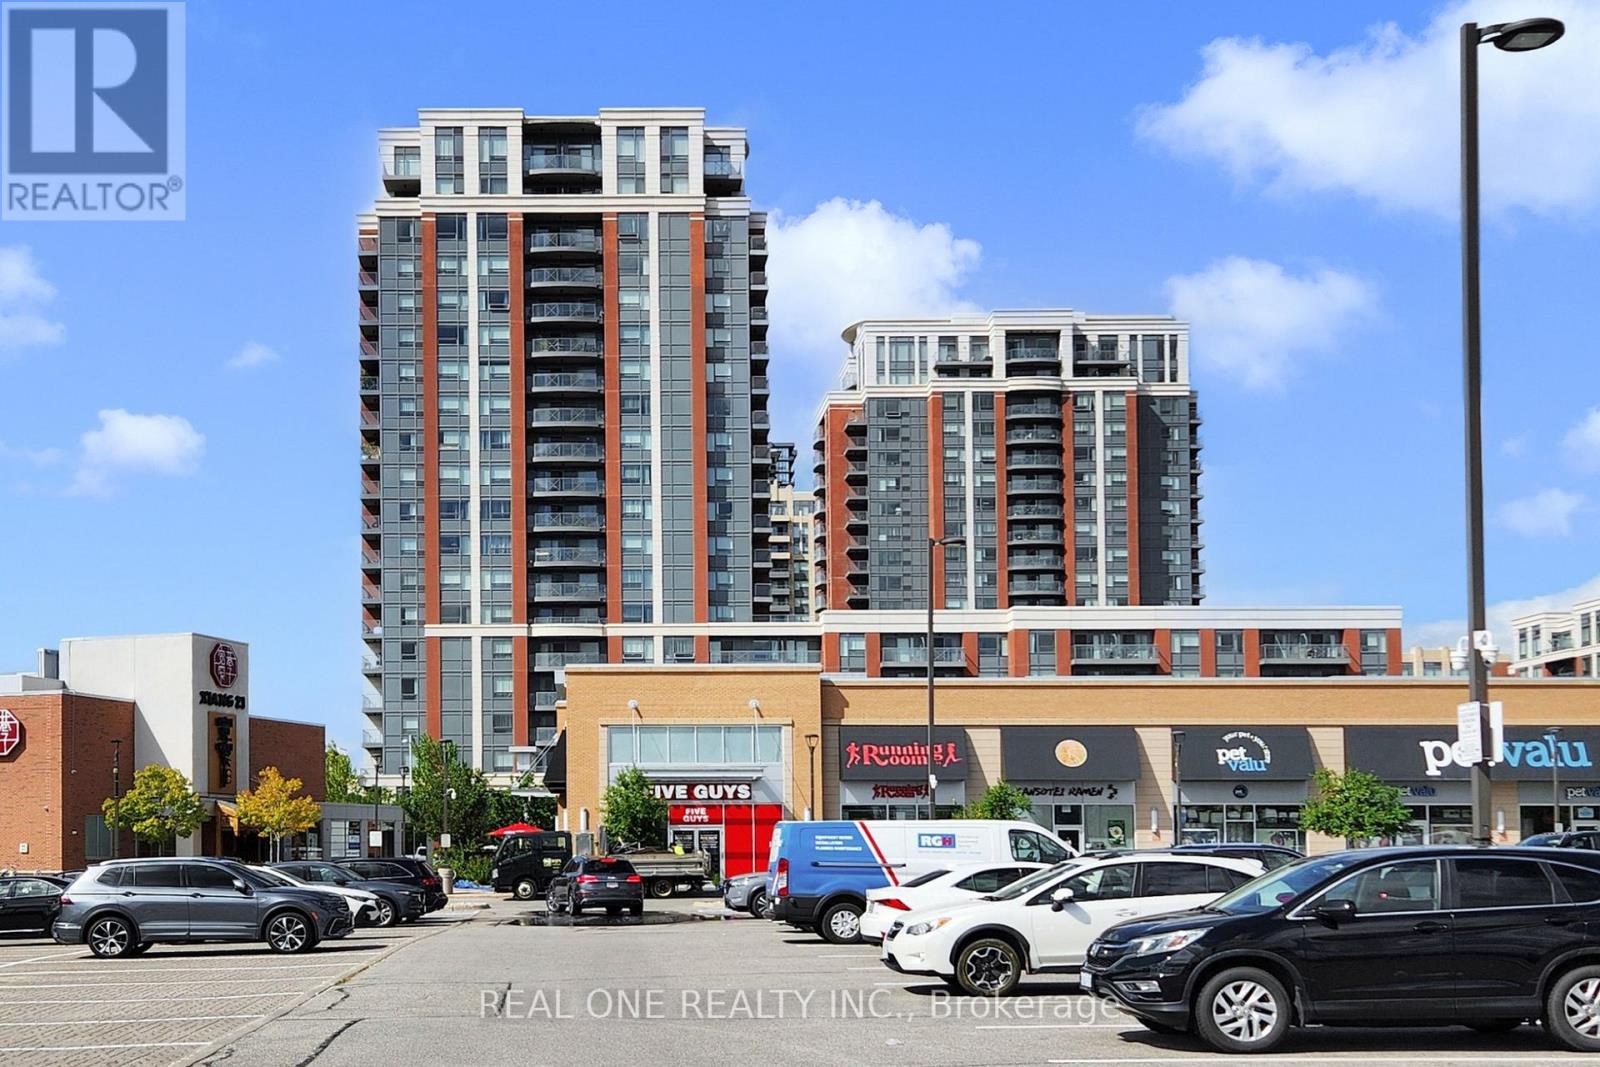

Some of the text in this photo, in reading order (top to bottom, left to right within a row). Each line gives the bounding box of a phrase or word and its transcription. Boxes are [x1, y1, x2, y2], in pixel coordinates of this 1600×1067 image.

[199, 691, 233, 707] XIANG
[862, 742, 944, 766] Running
[1216, 746, 1248, 765] pet
[1503, 734, 1593, 767] valu
[1226, 757, 1267, 772] valu
[693, 784, 752, 799] GUYS
[1068, 787, 1104, 796] RAMEN
[1567, 787, 1586, 800] pet
[685, 807, 707, 815] FIVE
[683, 815, 709, 823] GUYS
